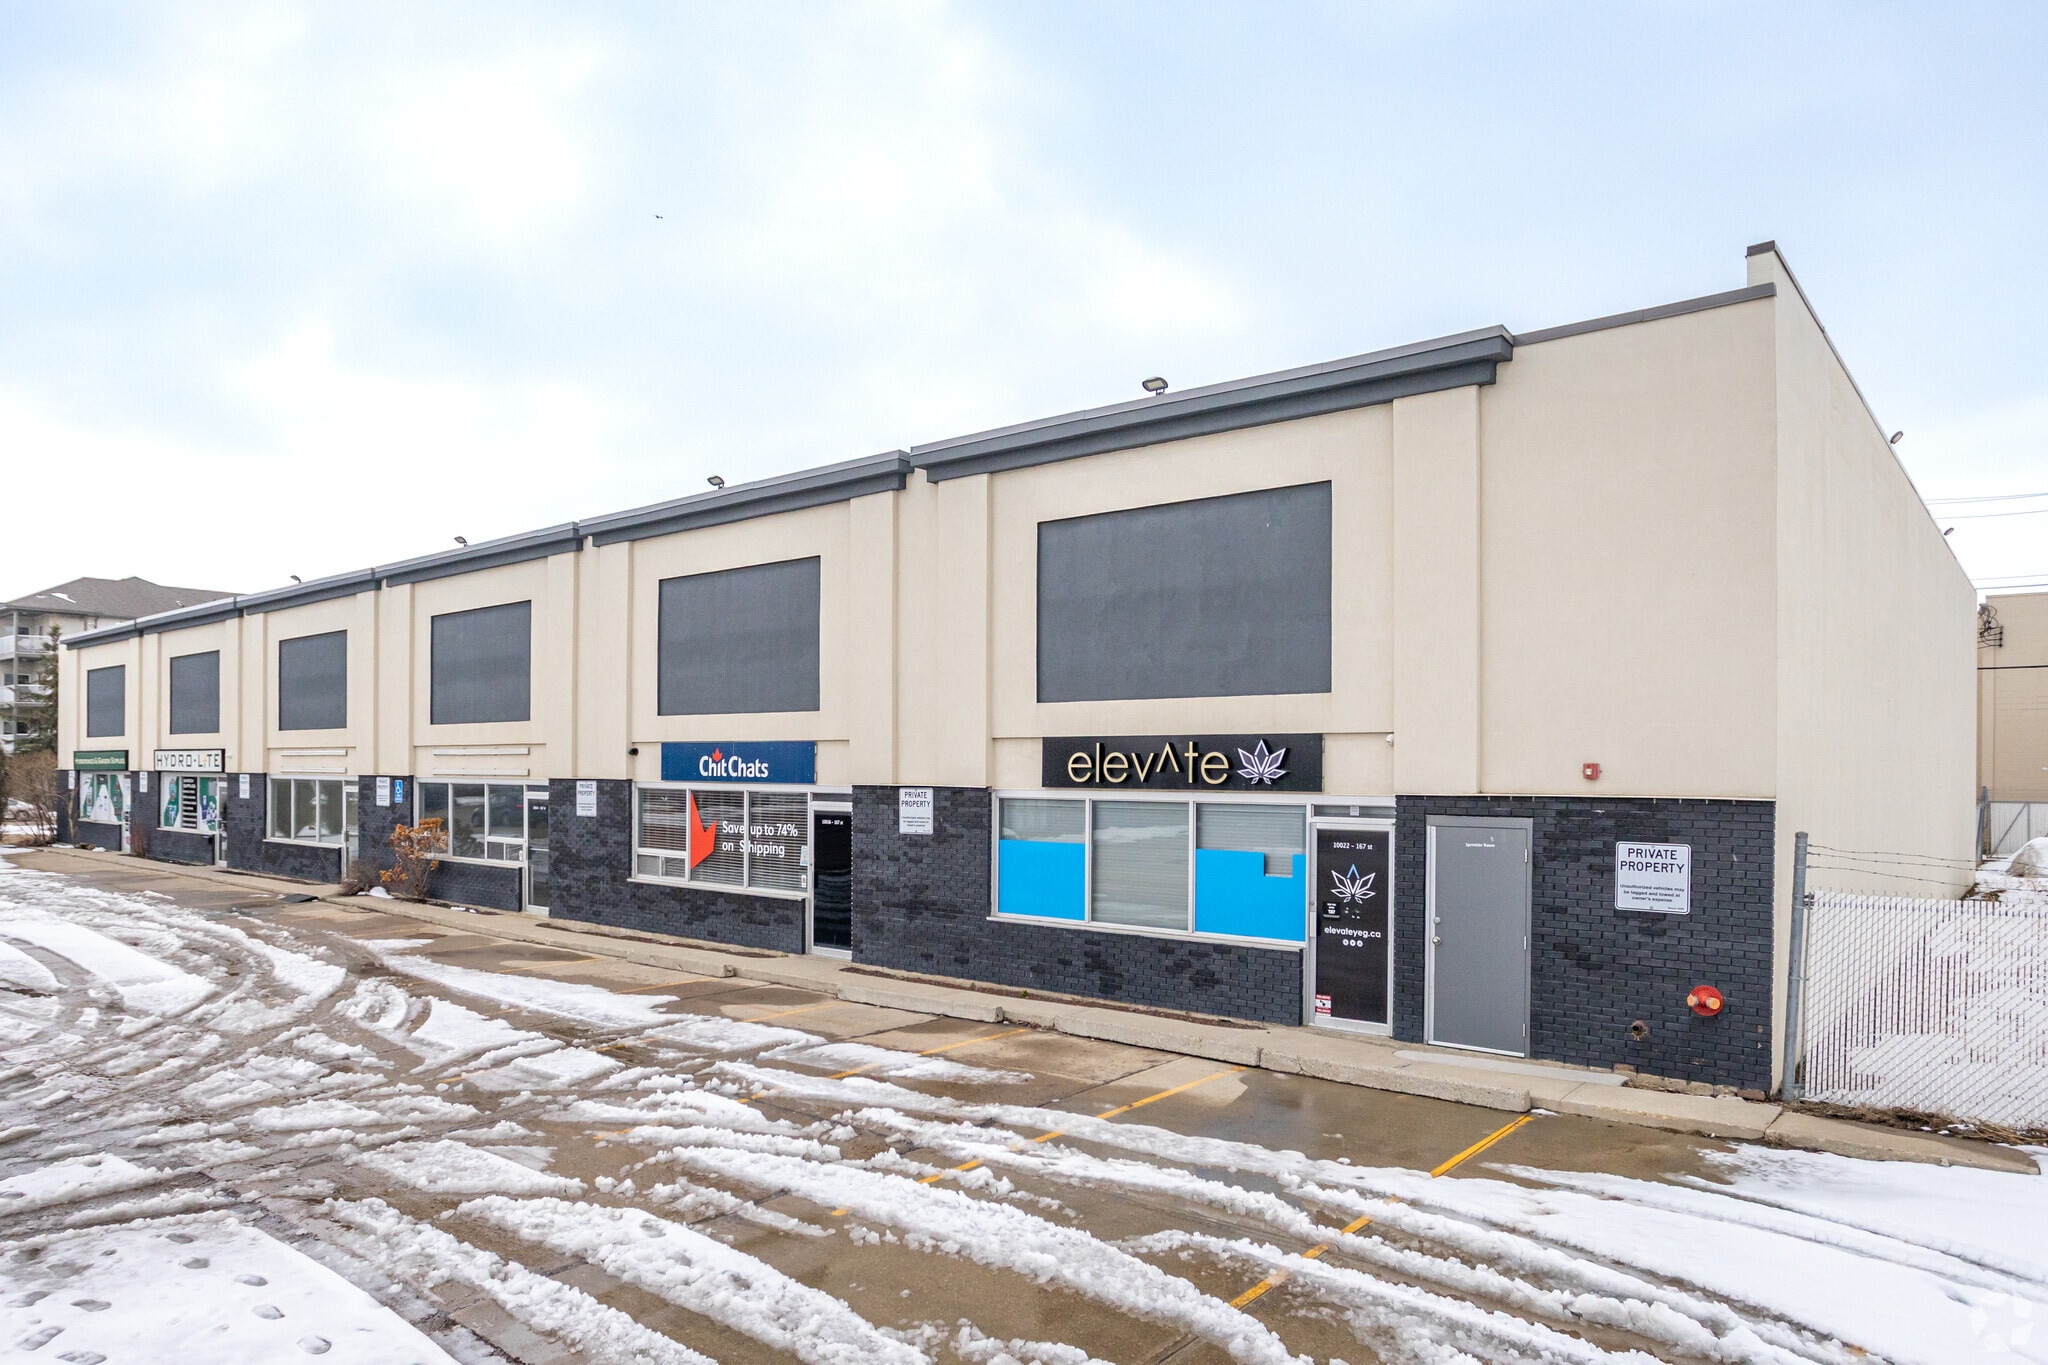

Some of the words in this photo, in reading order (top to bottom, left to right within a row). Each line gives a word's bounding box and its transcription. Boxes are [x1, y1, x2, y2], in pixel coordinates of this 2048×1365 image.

[699, 755, 727, 777] Chit
[728, 755, 769, 778] Chats
[904, 791, 928, 799] PRIVATE
[901, 800, 931, 808] PROPERTY
[722, 821, 745, 834] Save
[750, 825, 763, 838] up
[764, 824, 775, 836] to
[776, 823, 799, 837] 74%
[722, 842, 734, 852] on
[739, 840, 785, 858] Shipping
[1627, 848, 1677, 860] PRIVATE
[1620, 860, 1685, 873] PROPERTY
[1324, 926, 1381, 939] elevateyeg.ca
